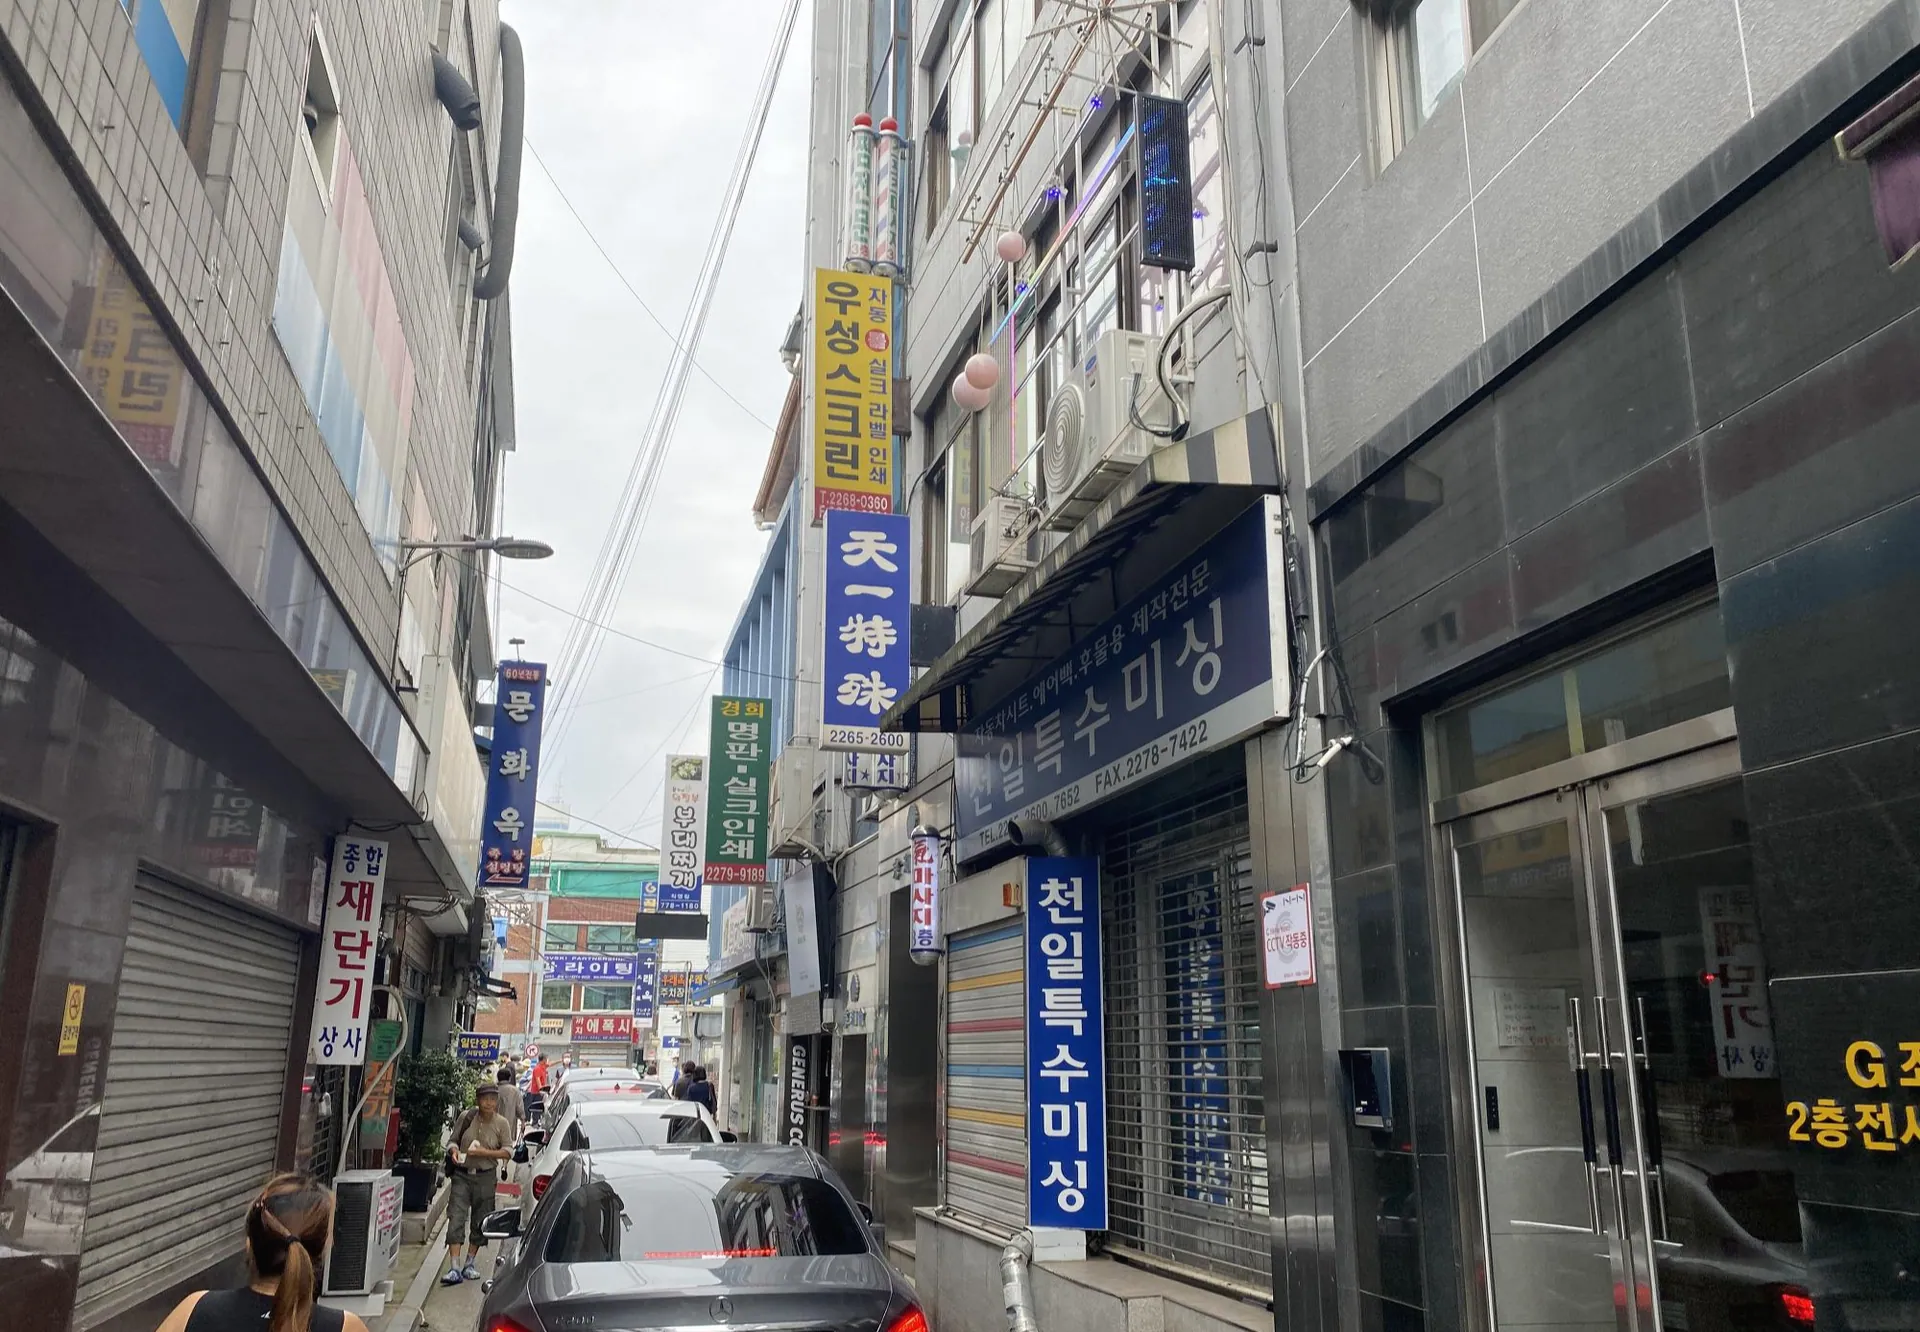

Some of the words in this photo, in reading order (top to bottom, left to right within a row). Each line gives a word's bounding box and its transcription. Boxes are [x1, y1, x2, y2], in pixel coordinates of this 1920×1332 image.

[868, 287, 888, 323] 자동
[824, 281, 862, 481] 우성스크린
[868, 358, 887, 395] 실크
[869, 402, 888, 440] 라벨
[869, 448, 887, 485] 인쇄
[820, 490, 888, 511] T.2268-0360
[836, 531, 898, 714] 天一特殊
[720, 701, 764, 718] 경희
[829, 729, 904, 748] 2265-2600
[1095, 720, 1208, 794] FAX.2278-7422
[493, 690, 536, 842] 문화옥
[342, 843, 383, 877] 종합
[670, 805, 697, 889] 부대찌개
[706, 866, 765, 884] 2279-9189
[324, 880, 375, 1019] 재단기
[642, 957, 655, 1002] 우래옥
[318, 1026, 362, 1058] 상사
[460, 1037, 499, 1050] 일단정지
[586, 1019, 631, 1034] 에폭시
[1039, 876, 1090, 1213] 천일특수미싱
[1845, 1040, 1887, 1089] G
[790, 1045, 807, 1126] GENERUS
